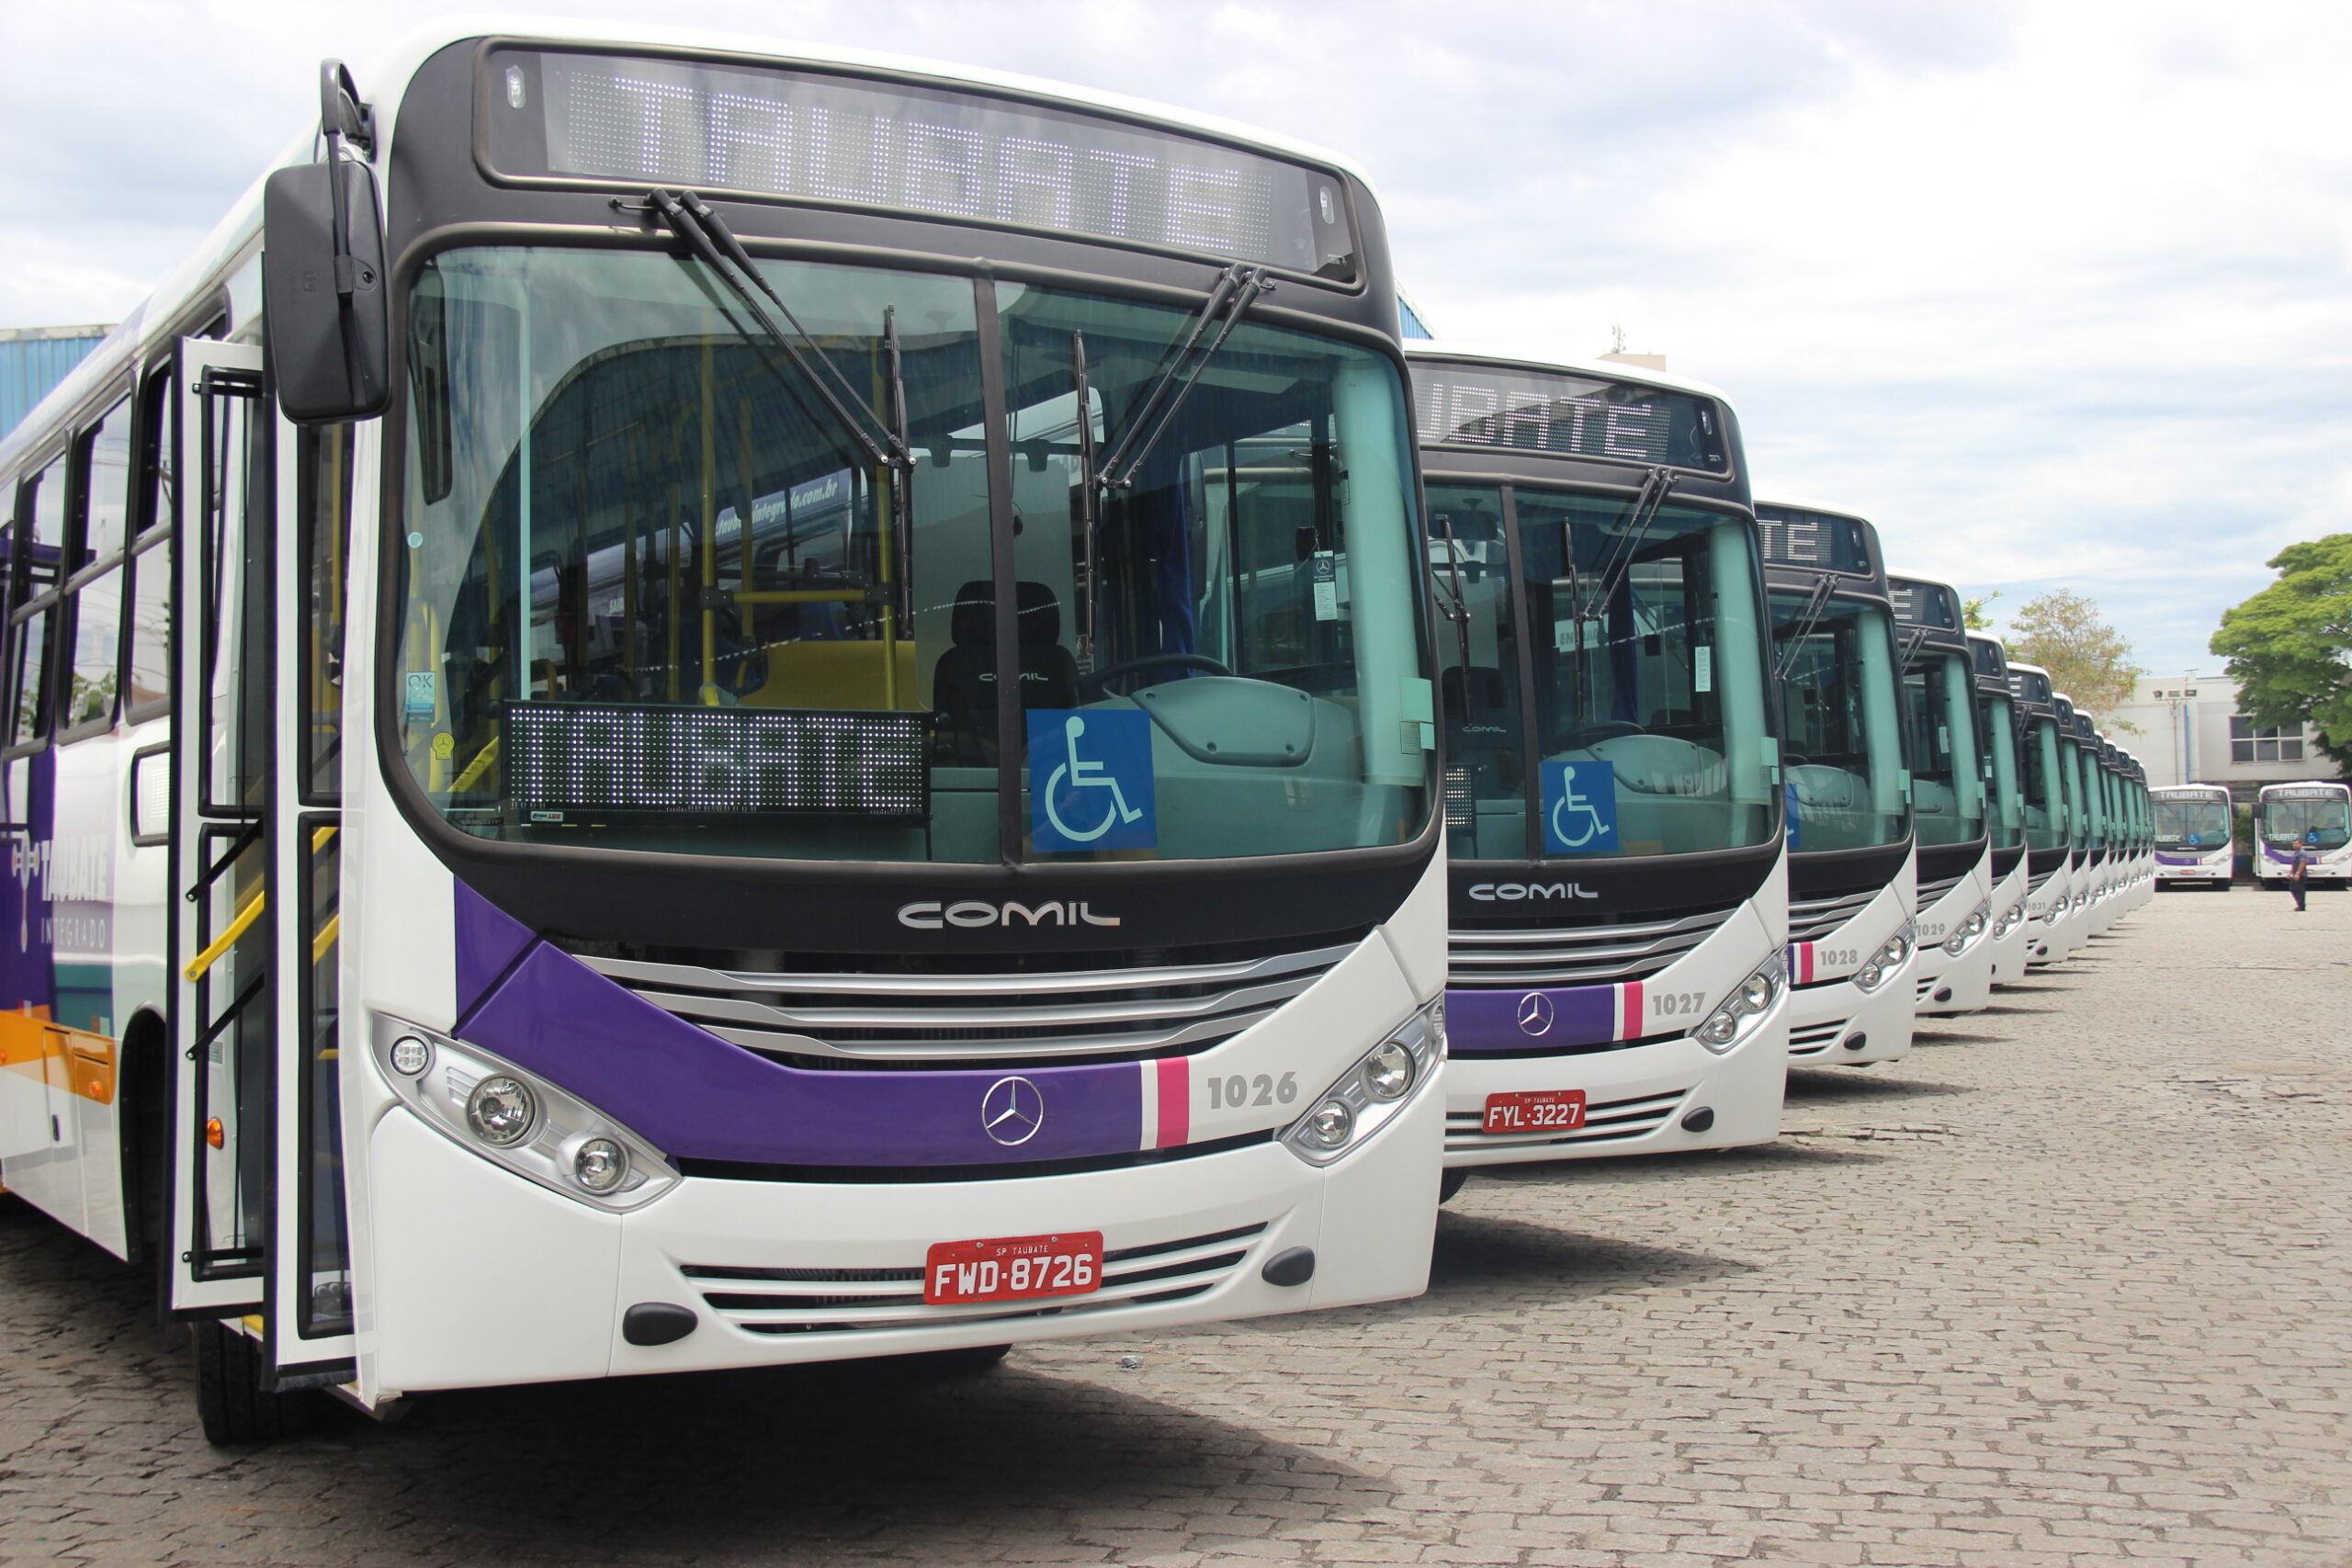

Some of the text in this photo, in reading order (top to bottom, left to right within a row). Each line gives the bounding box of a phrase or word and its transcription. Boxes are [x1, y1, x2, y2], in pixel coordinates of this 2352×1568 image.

[1468, 883, 1599, 901] COMIL
[897, 900, 1121, 930] COMIL
[1917, 923, 1946, 936] 1029
[1820, 949, 1858, 965] 1028
[1653, 992, 1706, 1016] 1027
[1207, 1071, 1298, 1110] 1026
[996, 1247, 1007, 1257] SP
